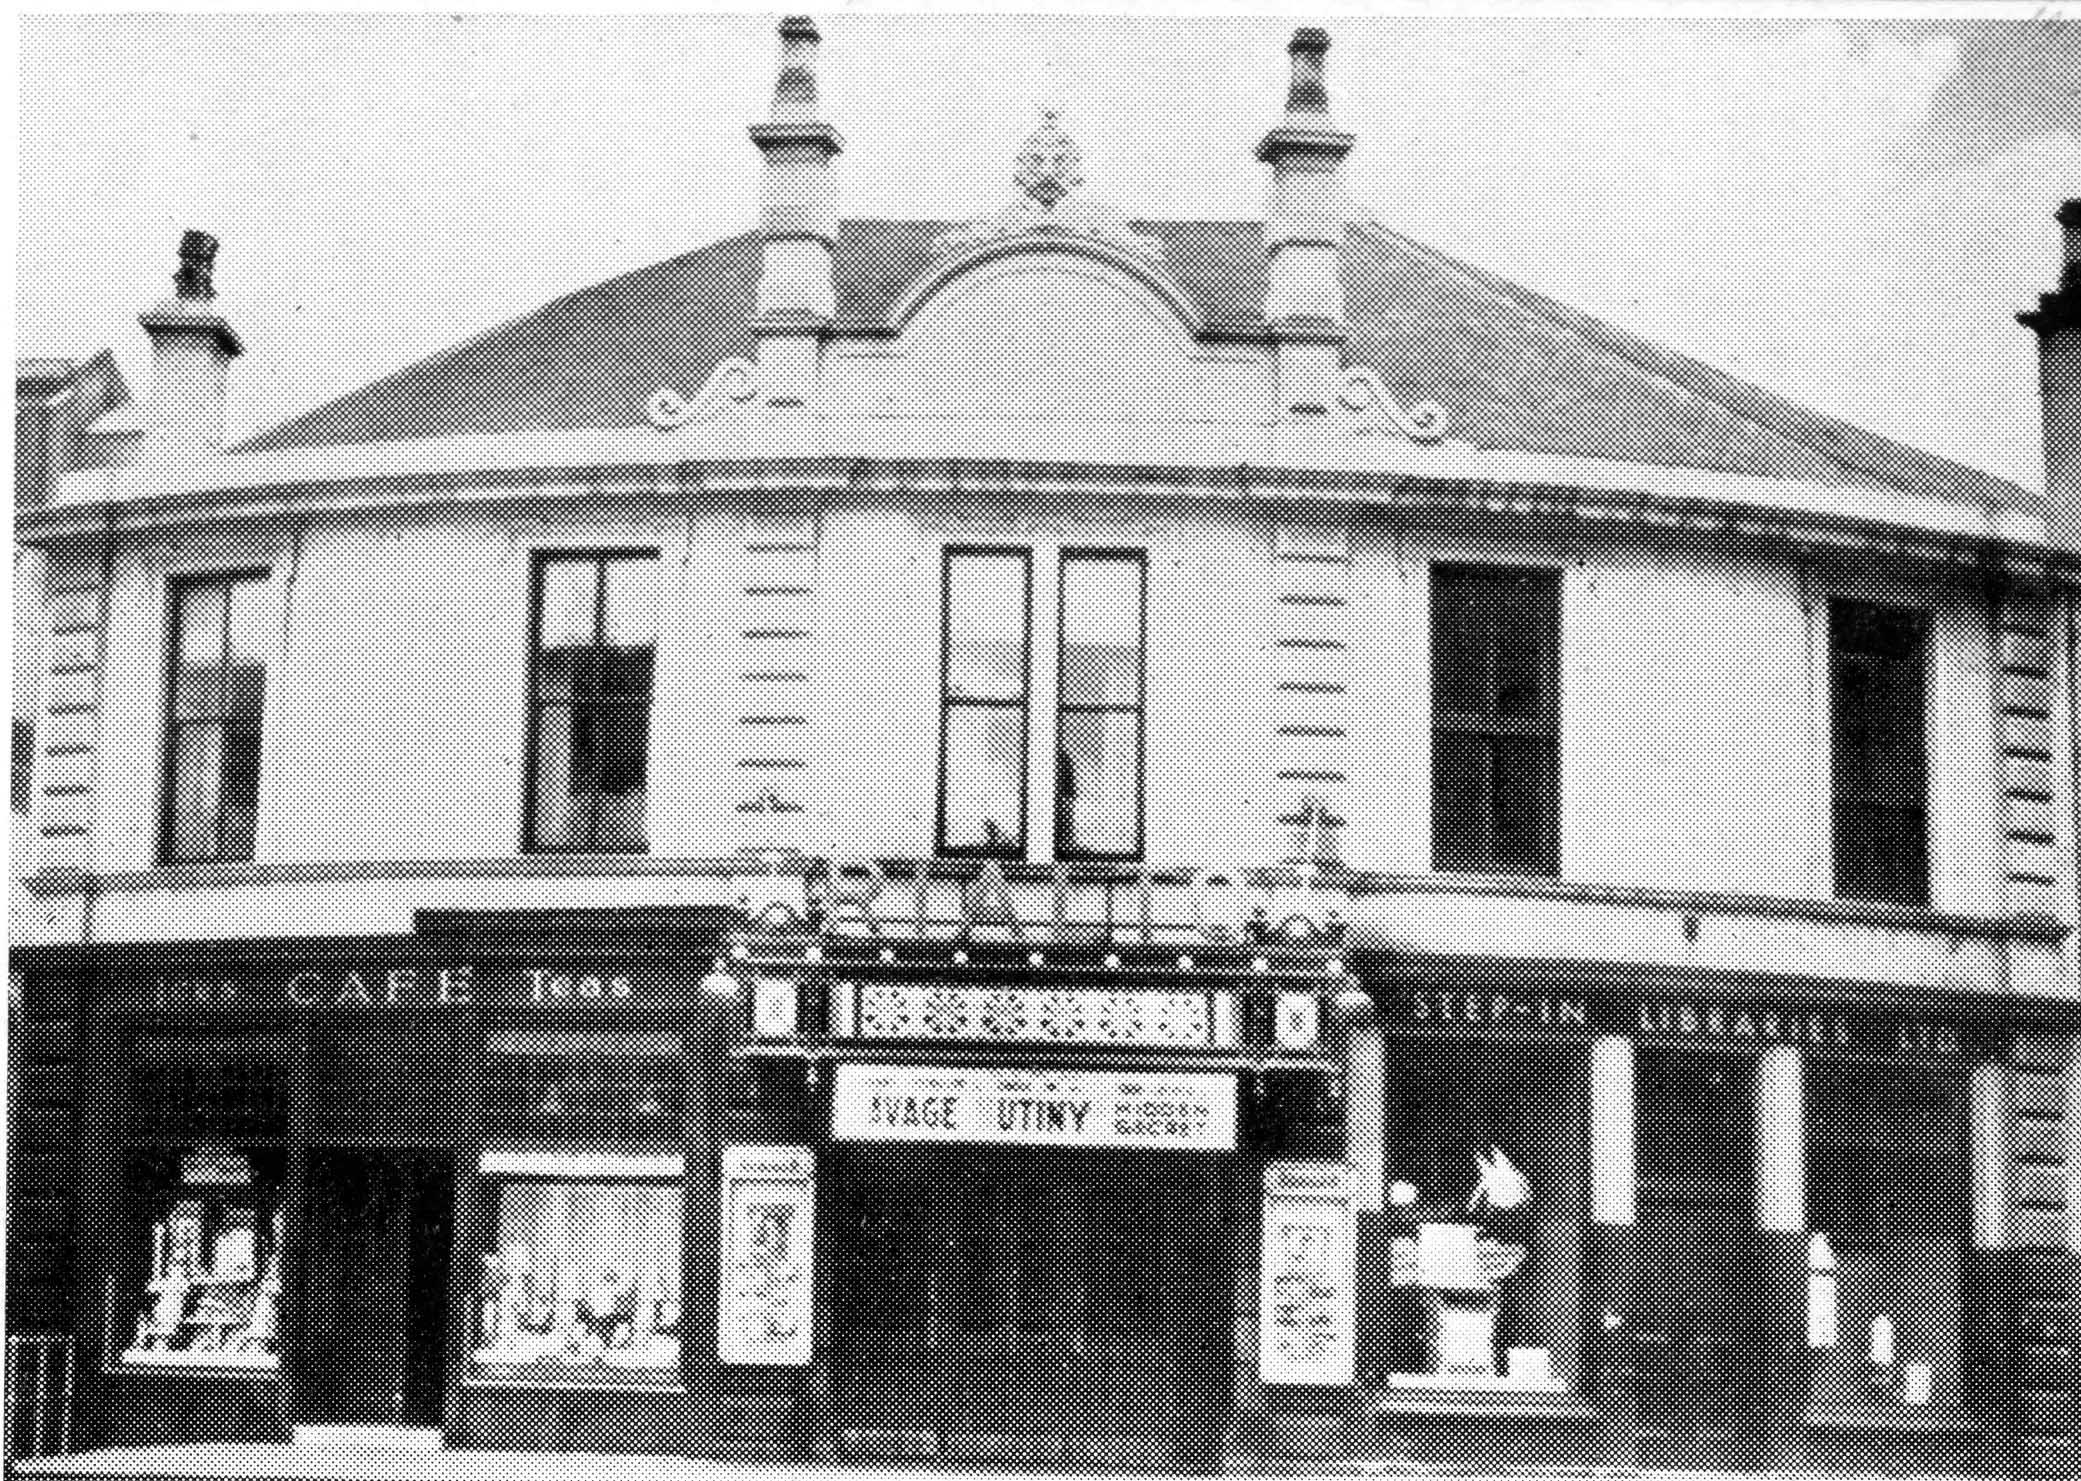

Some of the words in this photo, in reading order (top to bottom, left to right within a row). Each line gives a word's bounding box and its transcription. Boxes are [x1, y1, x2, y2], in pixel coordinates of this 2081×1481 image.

[520, 968, 632, 1002] Teas
[1412, 990, 1587, 1026] STEP-IN
[1637, 1003, 1850, 1045] LIBRARIES
